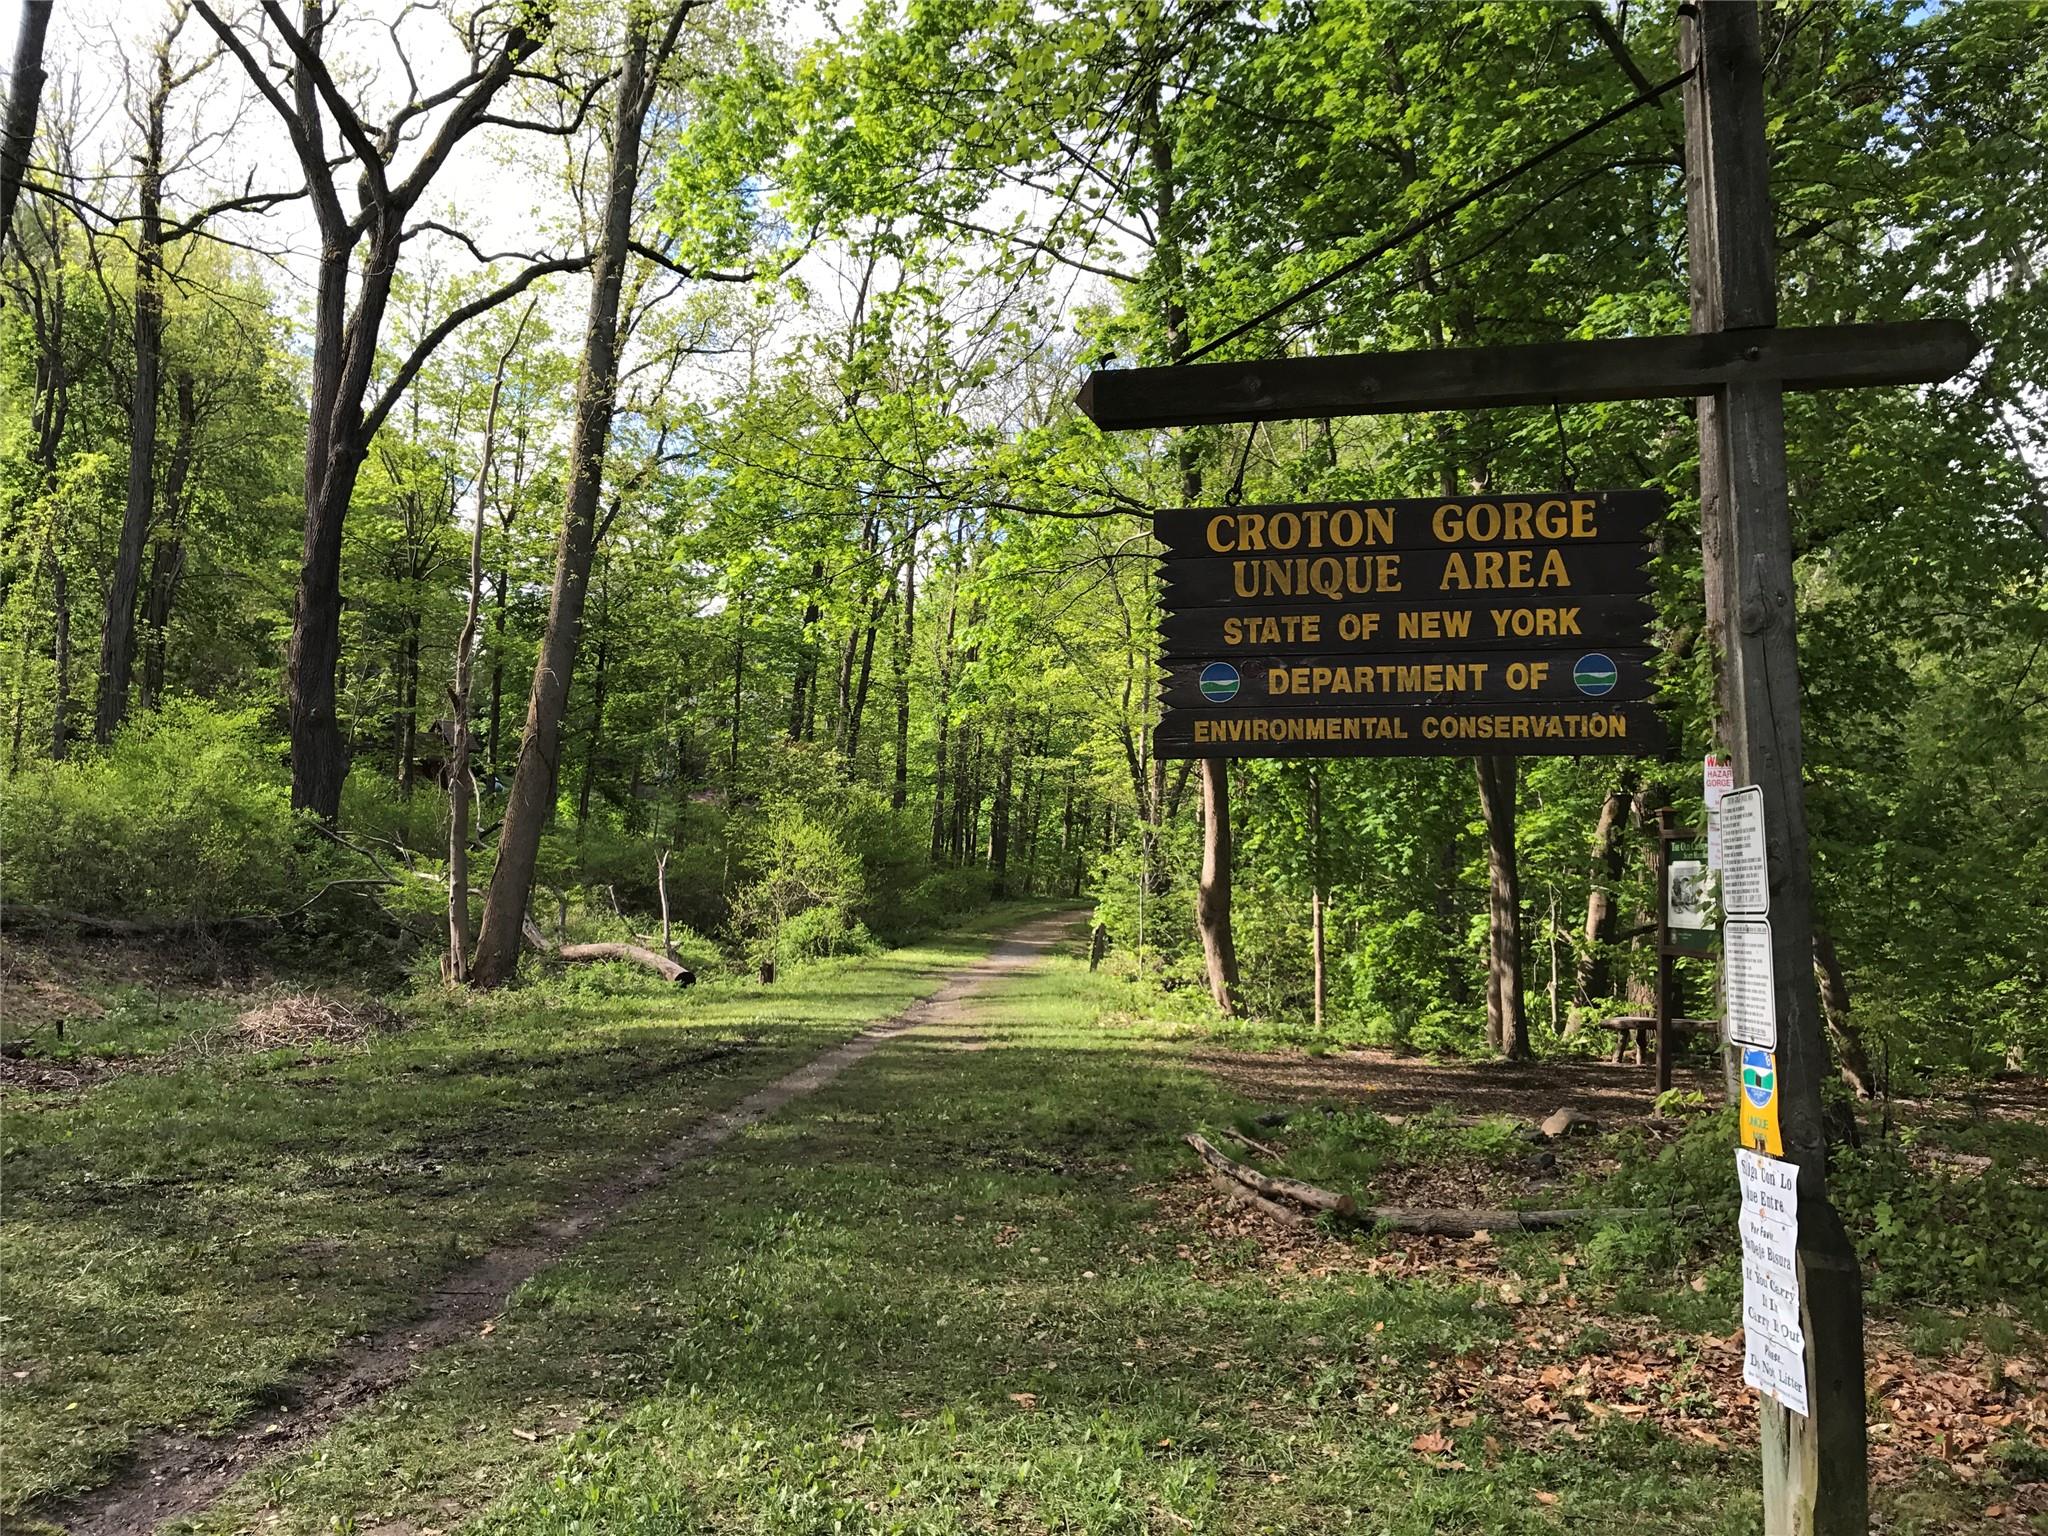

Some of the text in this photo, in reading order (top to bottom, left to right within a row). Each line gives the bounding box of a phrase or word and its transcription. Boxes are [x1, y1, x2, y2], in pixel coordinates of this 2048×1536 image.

[1206, 499, 1599, 553] CROTON GORGE
[1233, 548, 1571, 600] UNIQUE AREA
[1223, 607, 1582, 645] STATE OF NEW YORK
[1268, 662, 1550, 695] DEPARTMENT OF
[1194, 713, 1627, 743] ENVIRONMENTAL CONSERVATION
[1781, 1173, 1792, 1191] Lo
[1760, 1191, 1784, 1213] Entre
[1746, 1267, 1796, 1305] If You Carry
[1747, 1306, 1770, 1331] Carry
[1781, 1324, 1800, 1344] Out
[1762, 1360, 1776, 1379] Not
[1778, 1369, 1803, 1393] Litter
